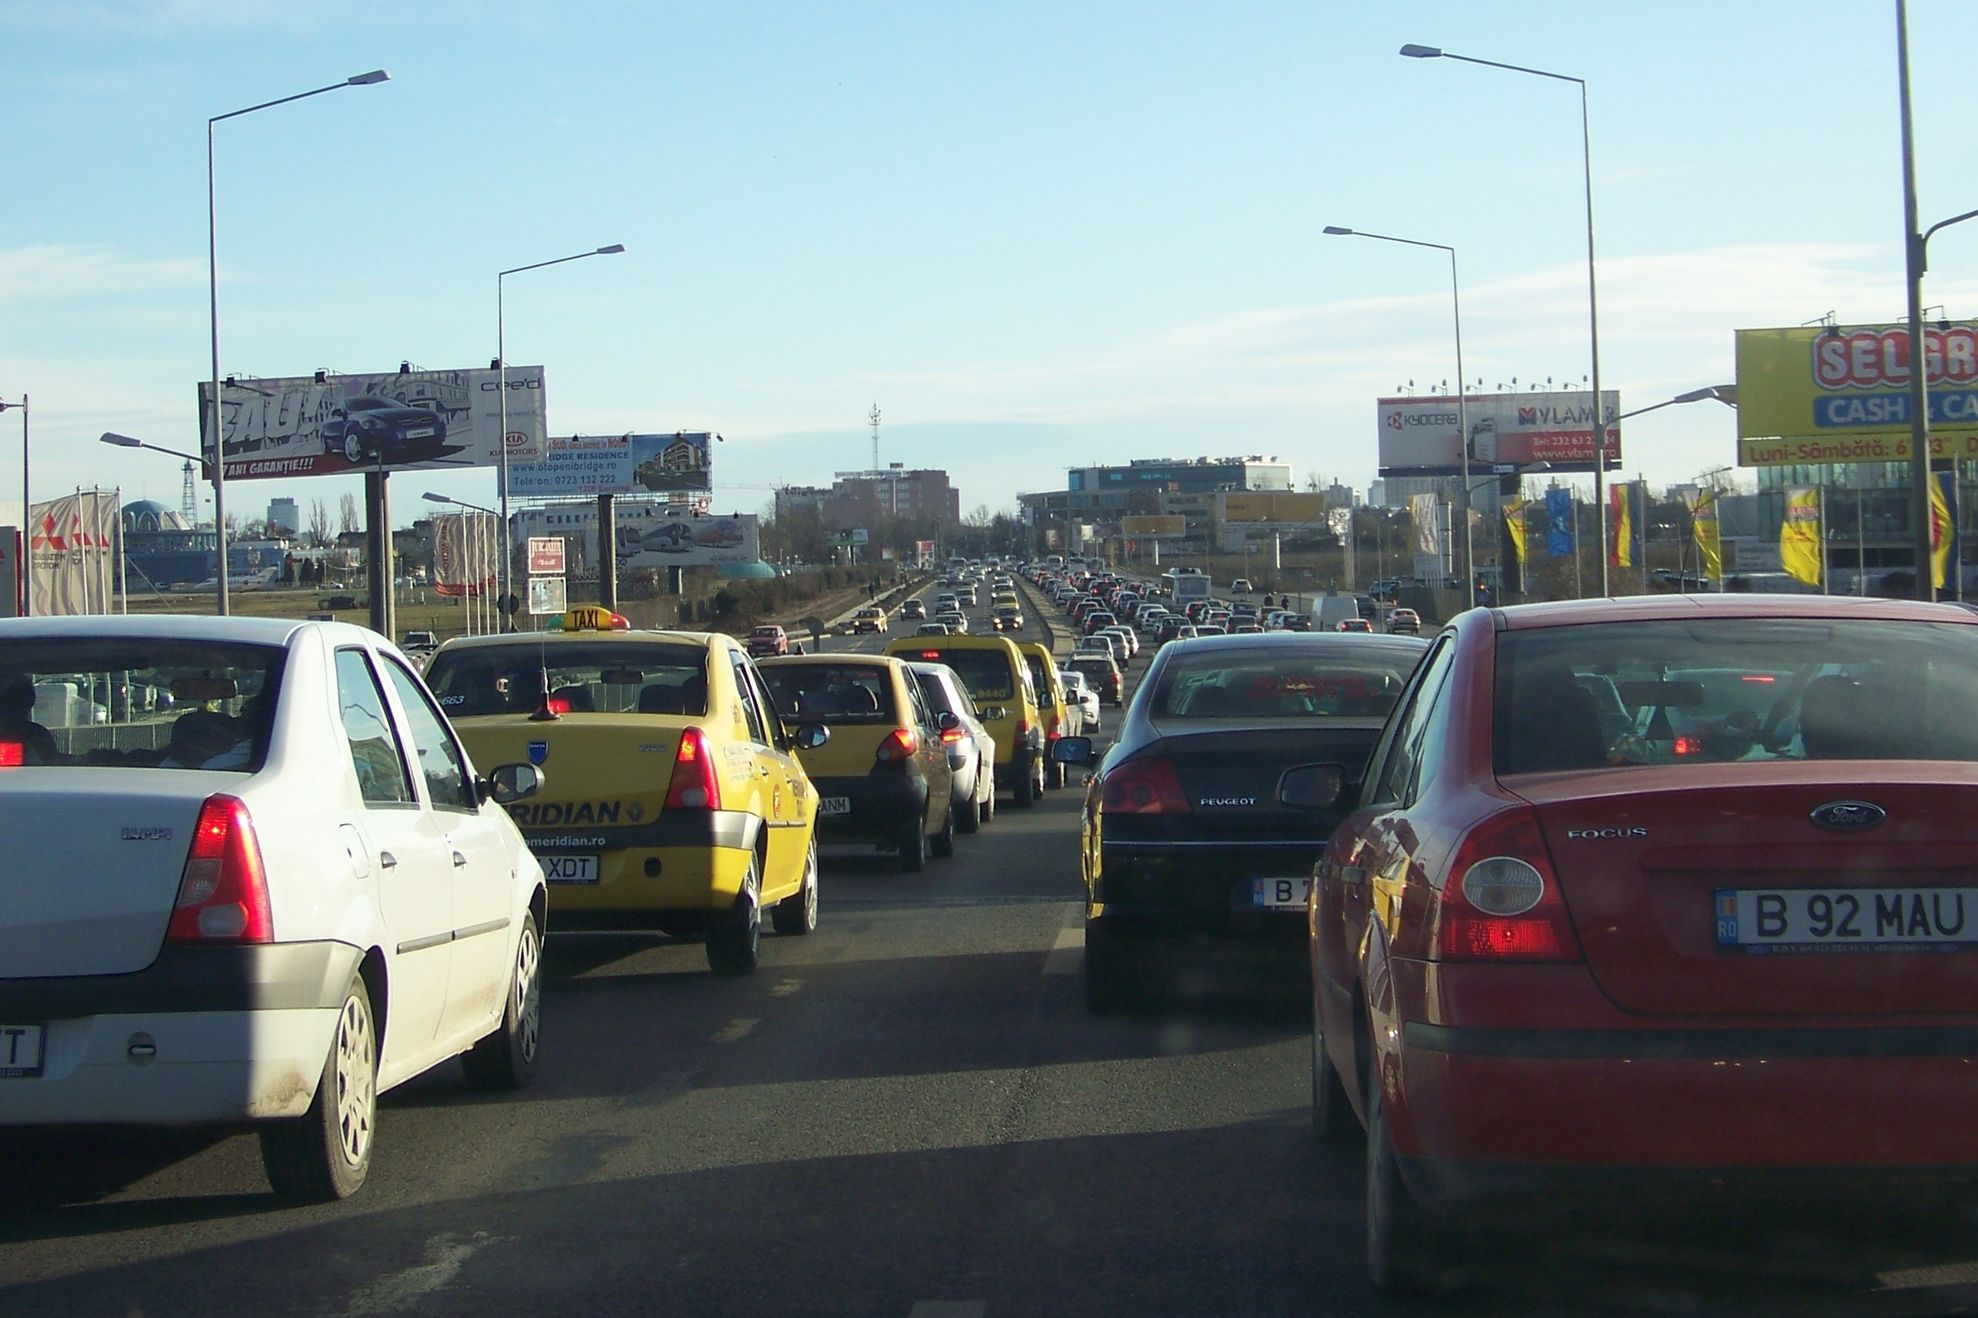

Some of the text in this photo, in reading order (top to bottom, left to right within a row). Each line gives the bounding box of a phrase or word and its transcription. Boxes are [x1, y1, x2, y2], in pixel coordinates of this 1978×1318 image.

[1538, 406, 1615, 425] VLAMR
[1828, 398, 1904, 423] CASH
[1404, 413, 1458, 426] KYOCERA
[1551, 435, 1570, 446] 232
[577, 451, 630, 460] RESIDENCE
[1749, 440, 1889, 462] Luni-Sâmbătă:
[229, 464, 246, 476] ANI
[512, 461, 618, 473] www.otopenibridge.ro
[555, 475, 577, 486] 0723
[581, 475, 597, 485] 132
[599, 474, 617, 485] 222
[571, 610, 599, 628] TAXI
[1200, 797, 1256, 806] PEUGEOT
[1828, 805, 1868, 823] Ford
[1568, 827, 1647, 839] FOCUS
[548, 858, 590, 878] XDT
[1275, 880, 1292, 902] B
[1718, 893, 1964, 938] RO B 92 MAU
